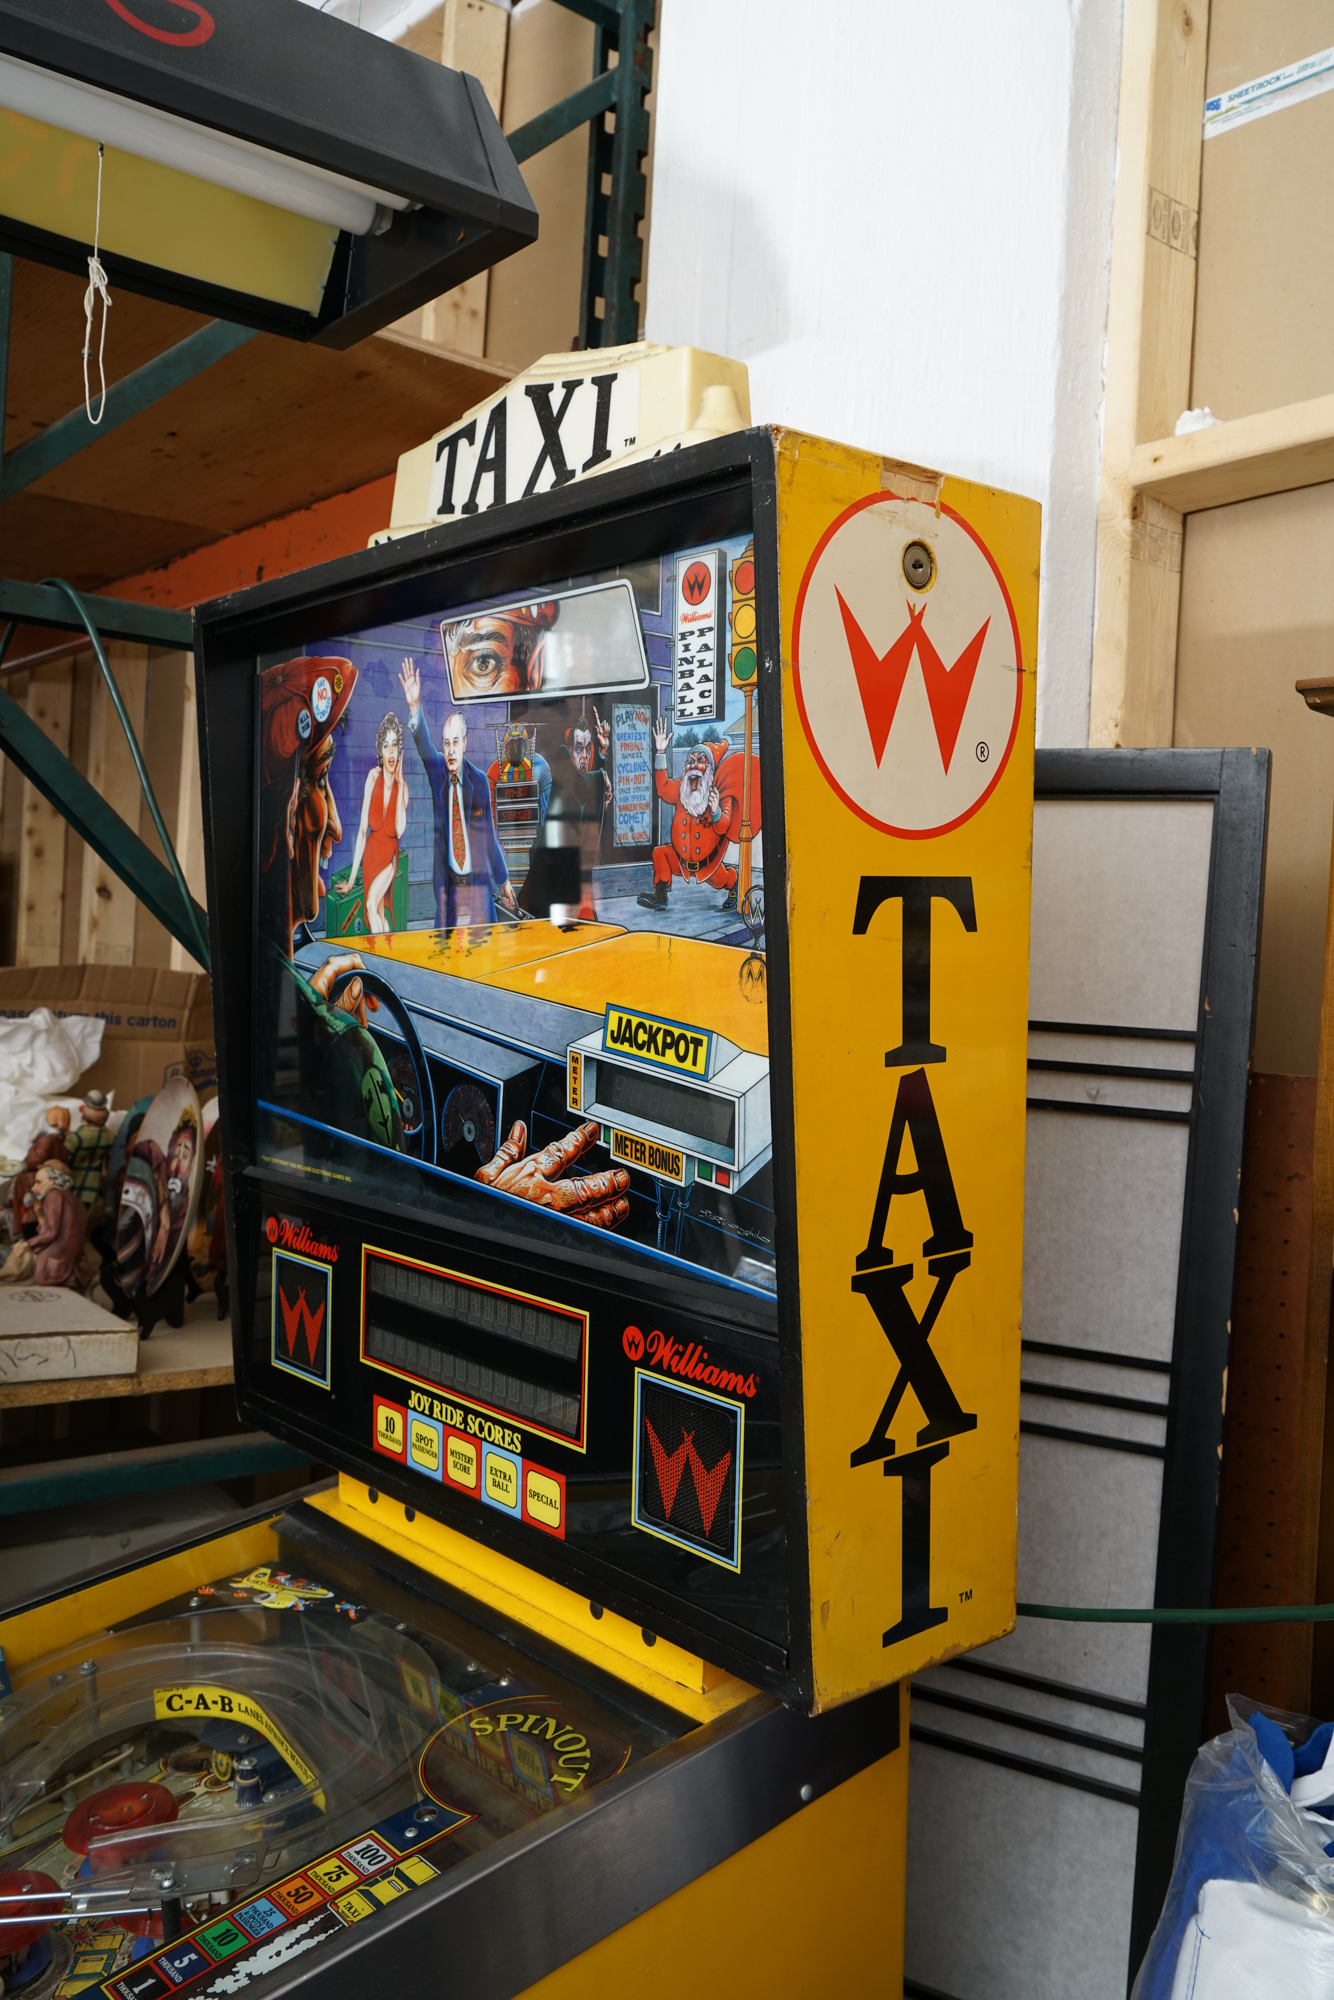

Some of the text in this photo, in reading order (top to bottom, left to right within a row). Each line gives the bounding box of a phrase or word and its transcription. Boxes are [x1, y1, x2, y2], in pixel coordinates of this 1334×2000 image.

[1227, 73, 1282, 102] SHEETROCK
[435, 373, 618, 515] TAXI
[678, 630, 695, 718] PINBALL
[696, 626, 714, 716] PALACE
[317, 687, 328, 702] NO
[615, 709, 650, 728] PLAY NOW
[616, 731, 648, 742] GREATEST
[620, 741, 645, 752] PINBALL
[617, 761, 648, 774] CYCLONE
[502, 809, 533, 821] STRANDED
[618, 811, 647, 825] COMET
[617, 830, 648, 842] BIG GUNS
[127, 1013, 177, 1029] carton
[610, 1016, 704, 1068] JACKPOT
[571, 1055, 579, 1107] METER
[614, 1132, 681, 1177] METER BONUS
[279, 1218, 338, 1262] Williams
[851, 876, 977, 1648] TAXI
[646, 1329, 757, 1398] Williams
[385, 1415, 396, 1435] 10
[408, 1390, 522, 1454] JOY RIDE SCORES
[378, 1430, 402, 1447] THOUSAND
[415, 1432, 434, 1449] SPOT
[412, 1442, 438, 1460] PASSENGER
[449, 1448, 475, 1466] MYSTERY
[452, 1460, 471, 1475] SCORE
[489, 1465, 513, 1484] EXTRA
[492, 1477, 510, 1494] BALL
[528, 1488, 559, 1510] SPECIAL
[166, 1693, 234, 1713] C-A-B
[237, 1702, 264, 1725] LANES
[469, 1713, 591, 1792] SPINOUT
[343, 1851, 370, 1875] THOUSAND
[354, 1843, 388, 1867] 100
[309, 1870, 336, 1895] THOUSAND
[323, 1864, 350, 1883] 75
[273, 1890, 299, 1916] THOUSAND
[286, 1884, 314, 1905] 50
[249, 1904, 274, 1930] THOUSAND
[263, 1907, 277, 1918] 25
[342, 1900, 362, 1919] TAXI
[236, 1912, 262, 1937] PASSENGER
[199, 1934, 224, 1960] THOUSAND
[211, 1927, 239, 1947] 10
[158, 1956, 183, 1983] THOUSAND
[173, 1952, 199, 1969] 5
[133, 1978, 157, 1995] 1
